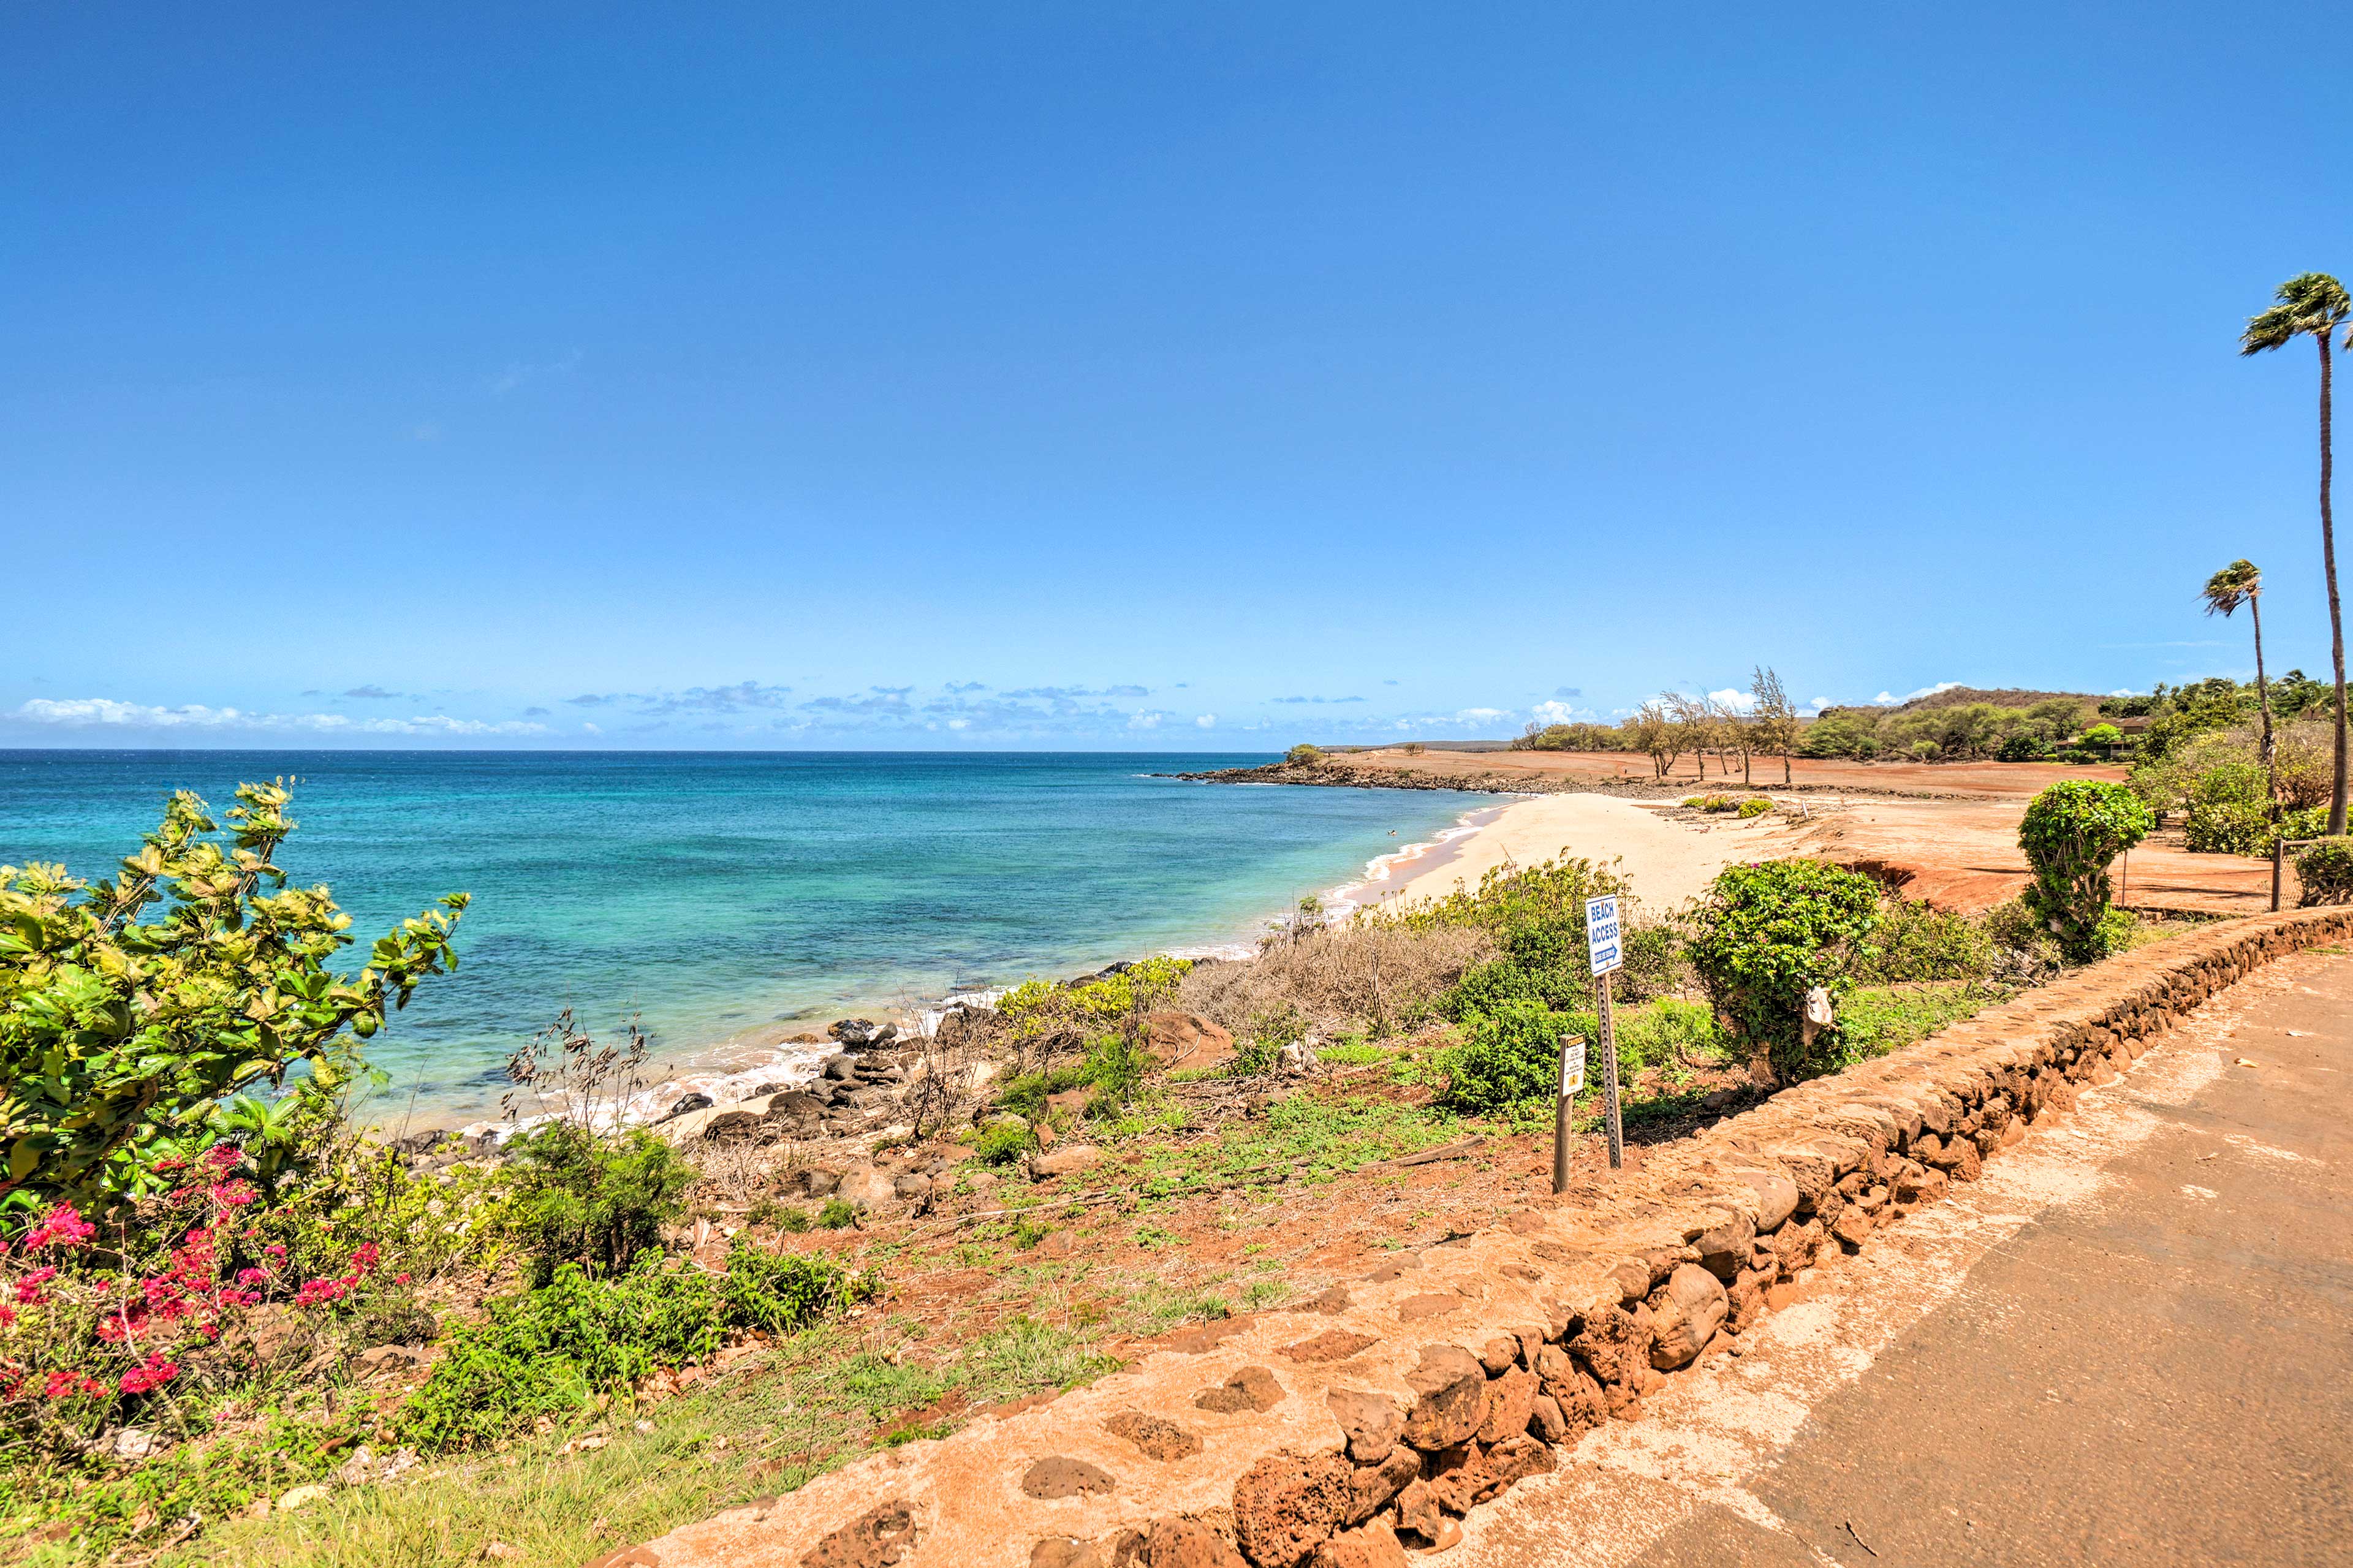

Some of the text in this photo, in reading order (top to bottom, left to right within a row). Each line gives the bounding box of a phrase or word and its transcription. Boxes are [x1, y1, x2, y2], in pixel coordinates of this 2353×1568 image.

[1591, 902, 1614, 922] BEACH
[1592, 922, 1618, 945] ACCESS
[1568, 1036, 1583, 1047] CAUTION
